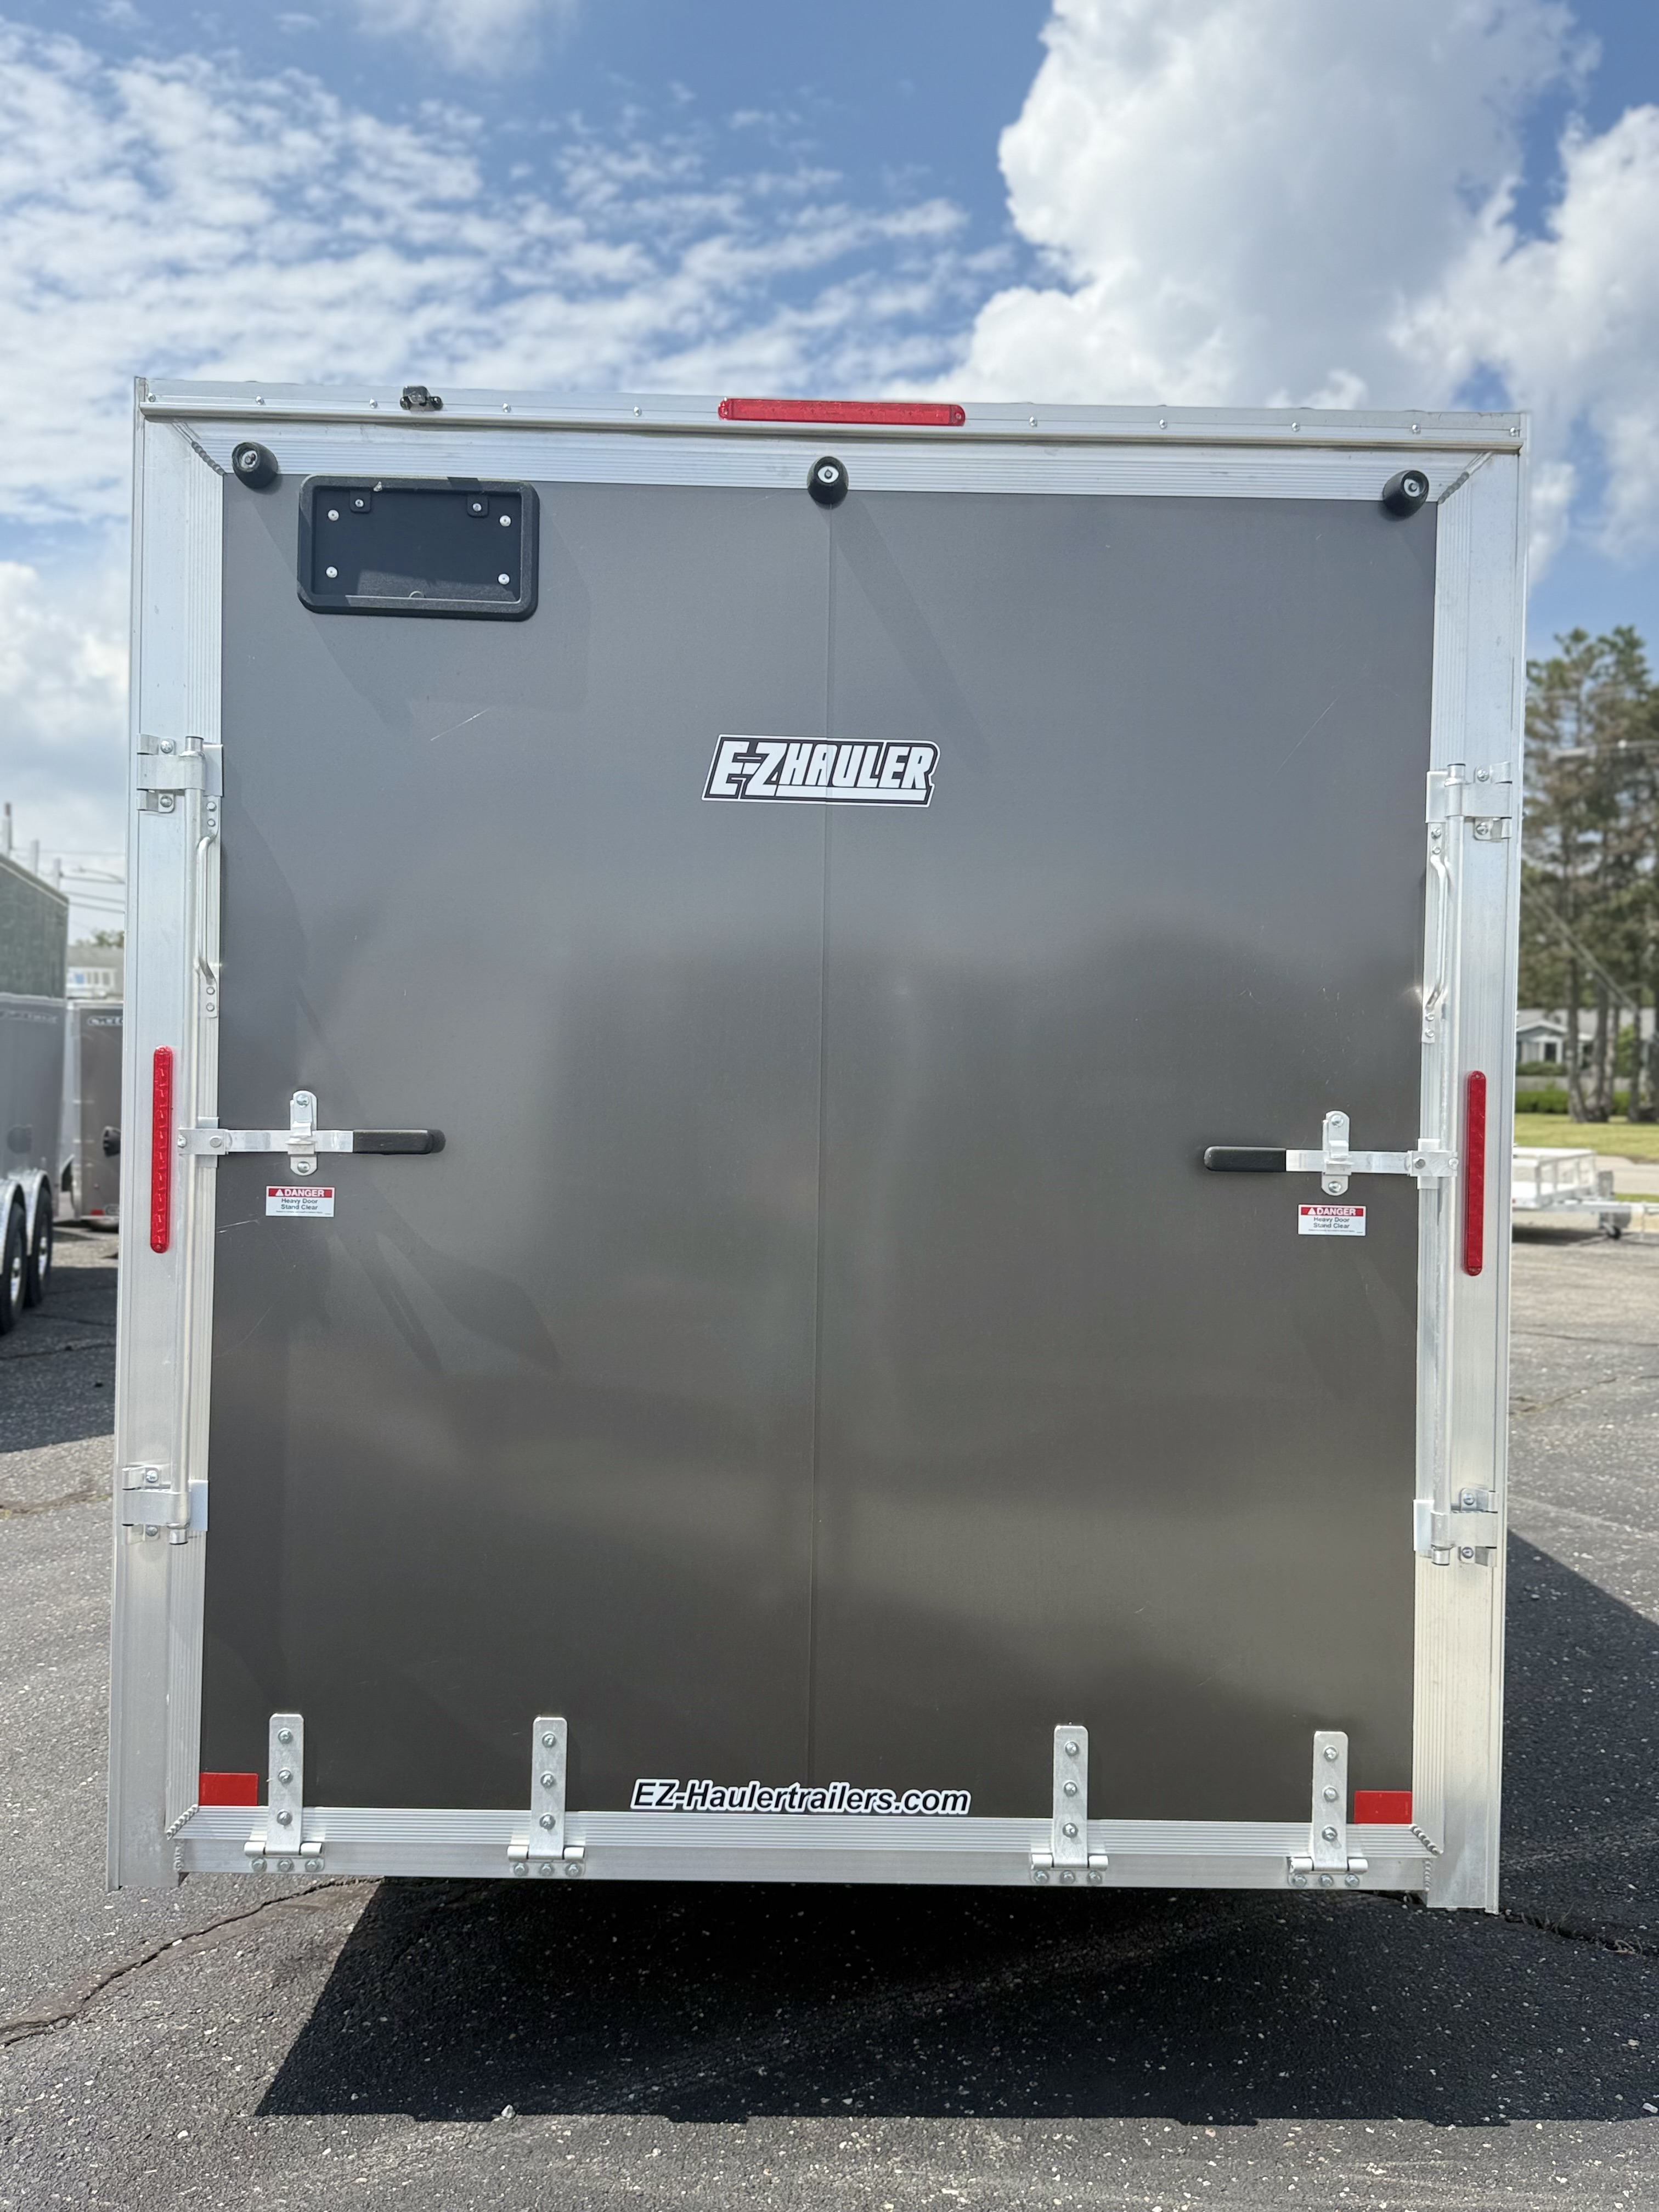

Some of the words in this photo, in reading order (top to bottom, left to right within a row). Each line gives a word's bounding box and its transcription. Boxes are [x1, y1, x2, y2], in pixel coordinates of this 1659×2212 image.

[284, 1189, 325, 1197] DANGER
[1316, 1207, 1357, 1216] DANGER
[633, 1781, 969, 1812] EZ-Haulertrailers.com
